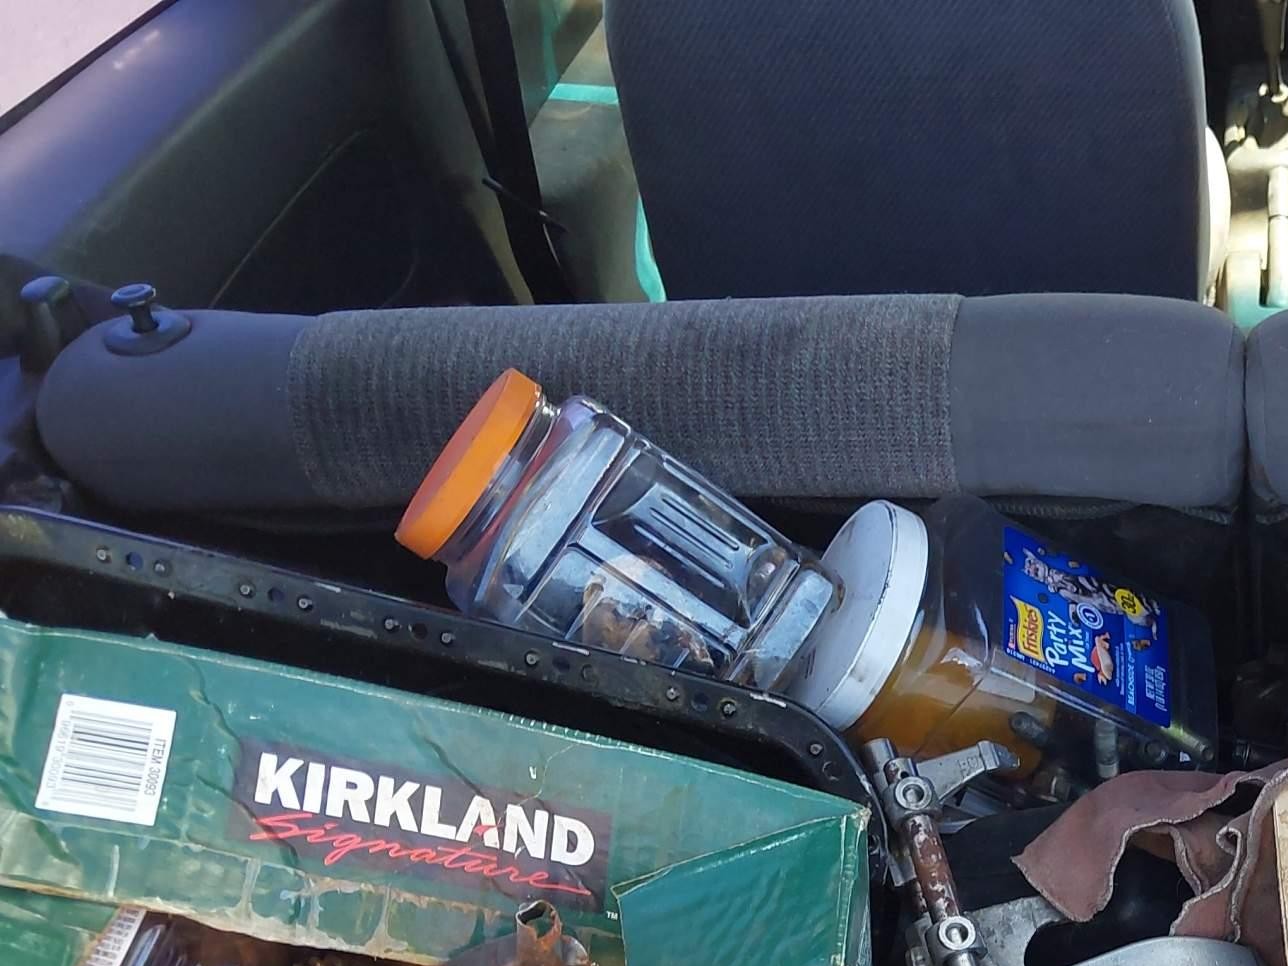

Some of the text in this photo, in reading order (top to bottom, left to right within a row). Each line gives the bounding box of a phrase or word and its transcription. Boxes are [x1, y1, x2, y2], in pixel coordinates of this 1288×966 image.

[1024, 602, 1040, 656] Friskies
[1045, 611, 1070, 667] Party
[1068, 624, 1095, 673] Mix
[144, 738, 166, 796] ITEM 30093
[254, 752, 595, 866] KIRKLAND
[250, 811, 592, 896] Signature
